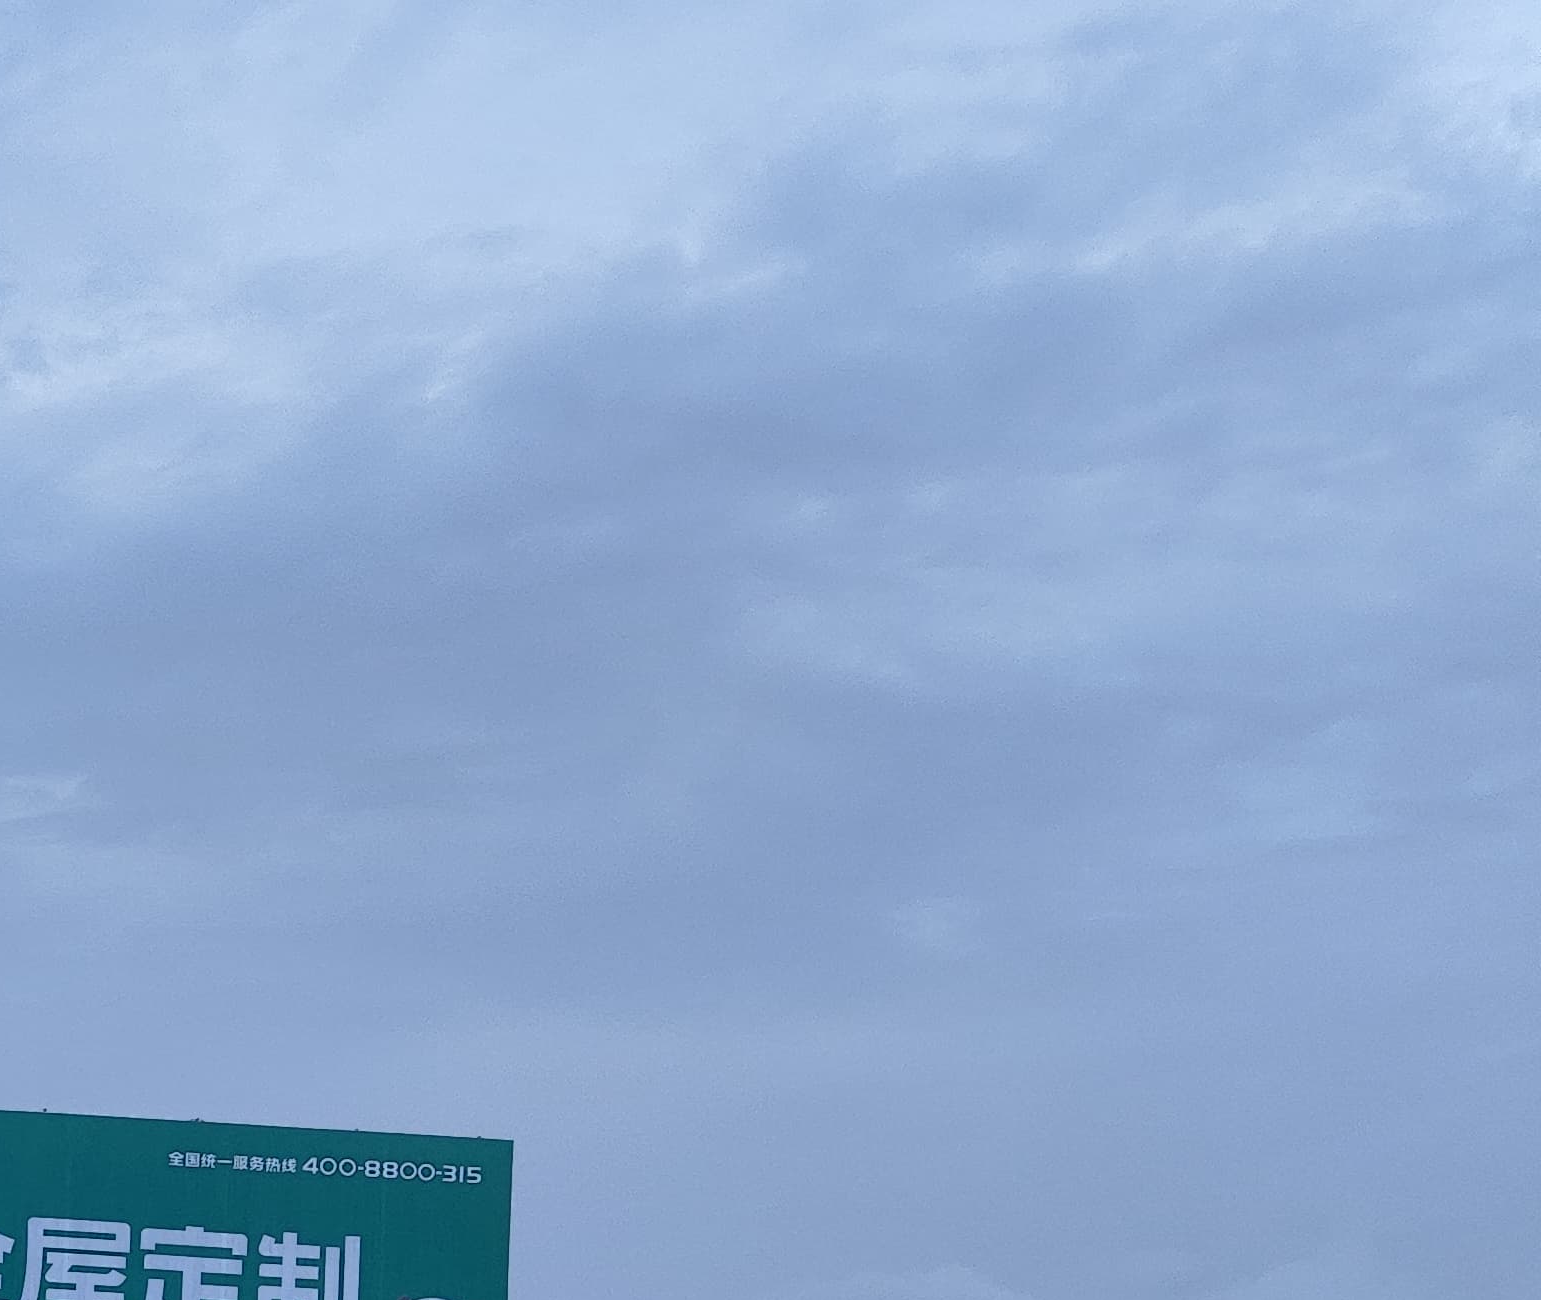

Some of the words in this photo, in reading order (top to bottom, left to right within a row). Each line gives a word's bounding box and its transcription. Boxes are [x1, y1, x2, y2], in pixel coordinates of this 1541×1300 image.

[168, 1151, 297, 1173] 全国统一服务热线
[302, 1156, 483, 1185] 400-8800-315
